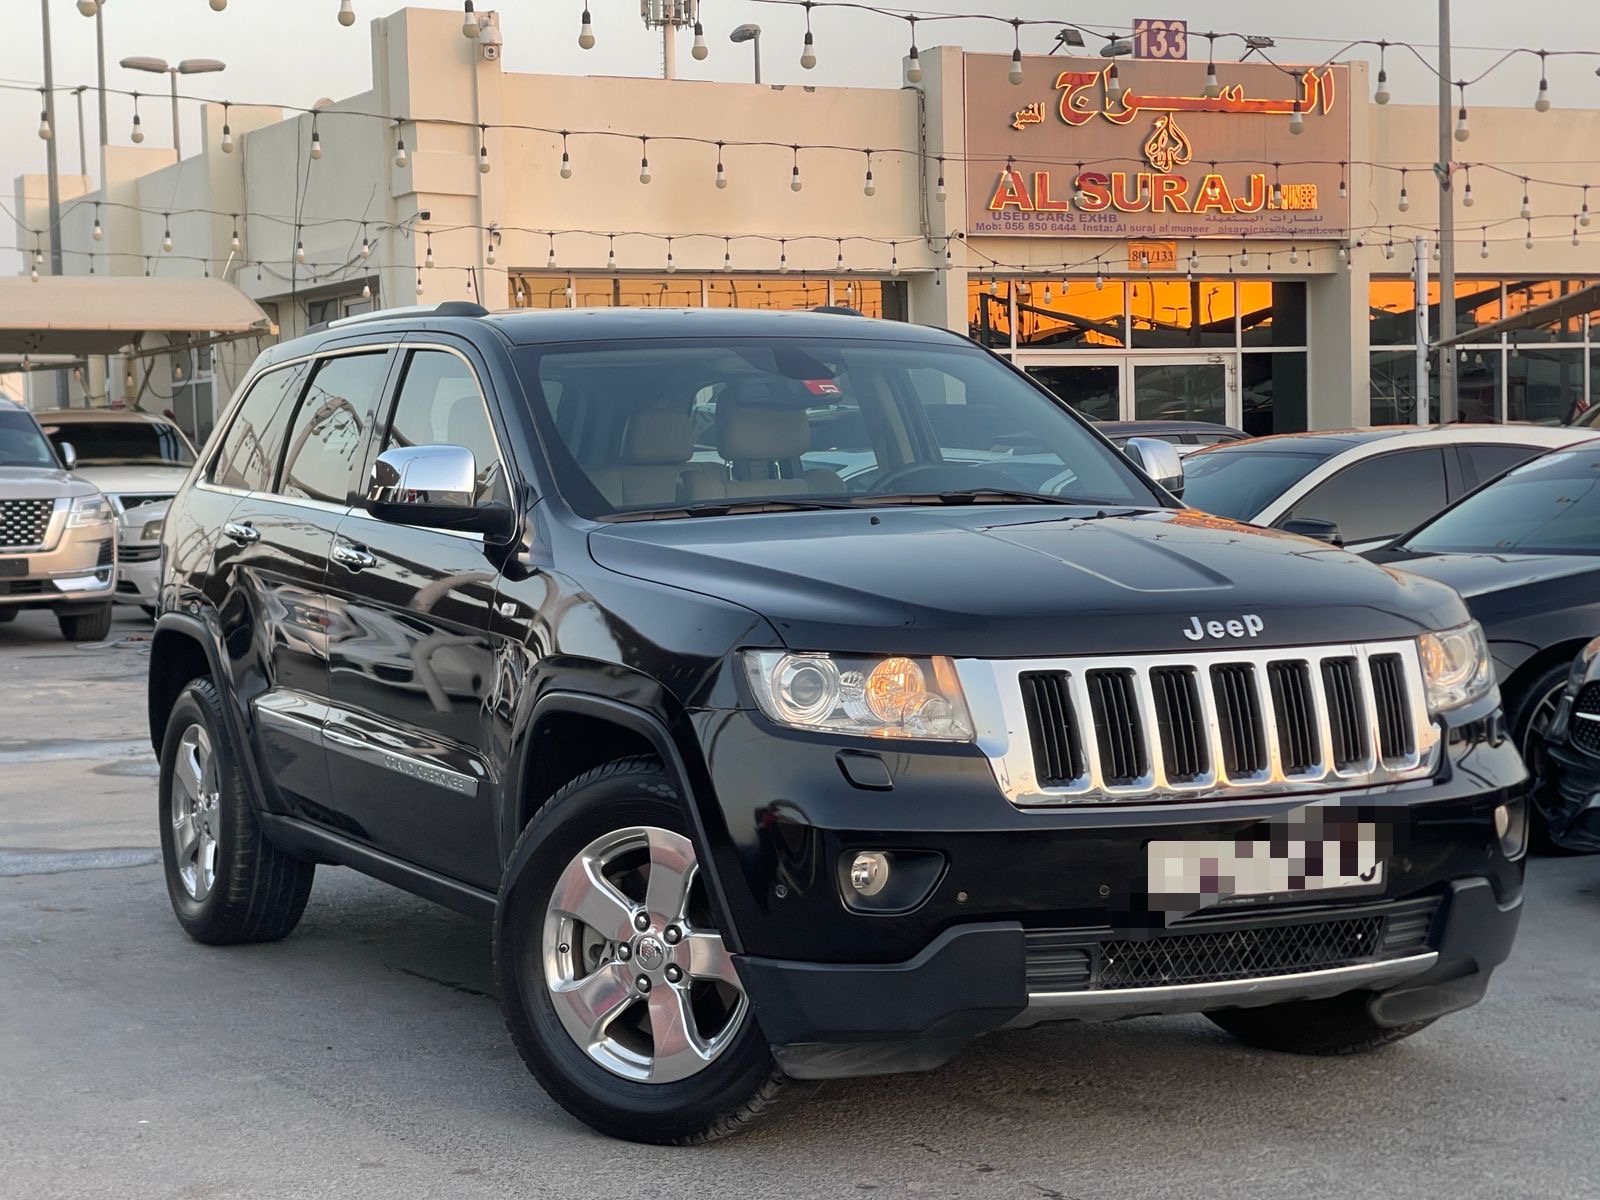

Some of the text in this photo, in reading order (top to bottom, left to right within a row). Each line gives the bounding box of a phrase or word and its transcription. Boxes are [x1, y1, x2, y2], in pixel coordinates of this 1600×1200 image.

[1135, 20, 1186, 58] 133
[1012, 62, 1336, 130] السراج المنير
[989, 170, 1266, 213] AL SURAJ
[975, 222, 1002, 231] Mob:
[1004, 222, 1025, 231] 056
[1028, 222, 1048, 231] 850
[1050, 223, 1077, 231] 6444
[1083, 223, 1113, 232] Insta:
[1116, 224, 1127, 232] Al
[1129, 224, 1156, 233] suraj
[1171, 225, 1210, 233] muneer
[992, 211, 1118, 223] USED CARS EXHB
[1183, 614, 1264, 641] Jeep
